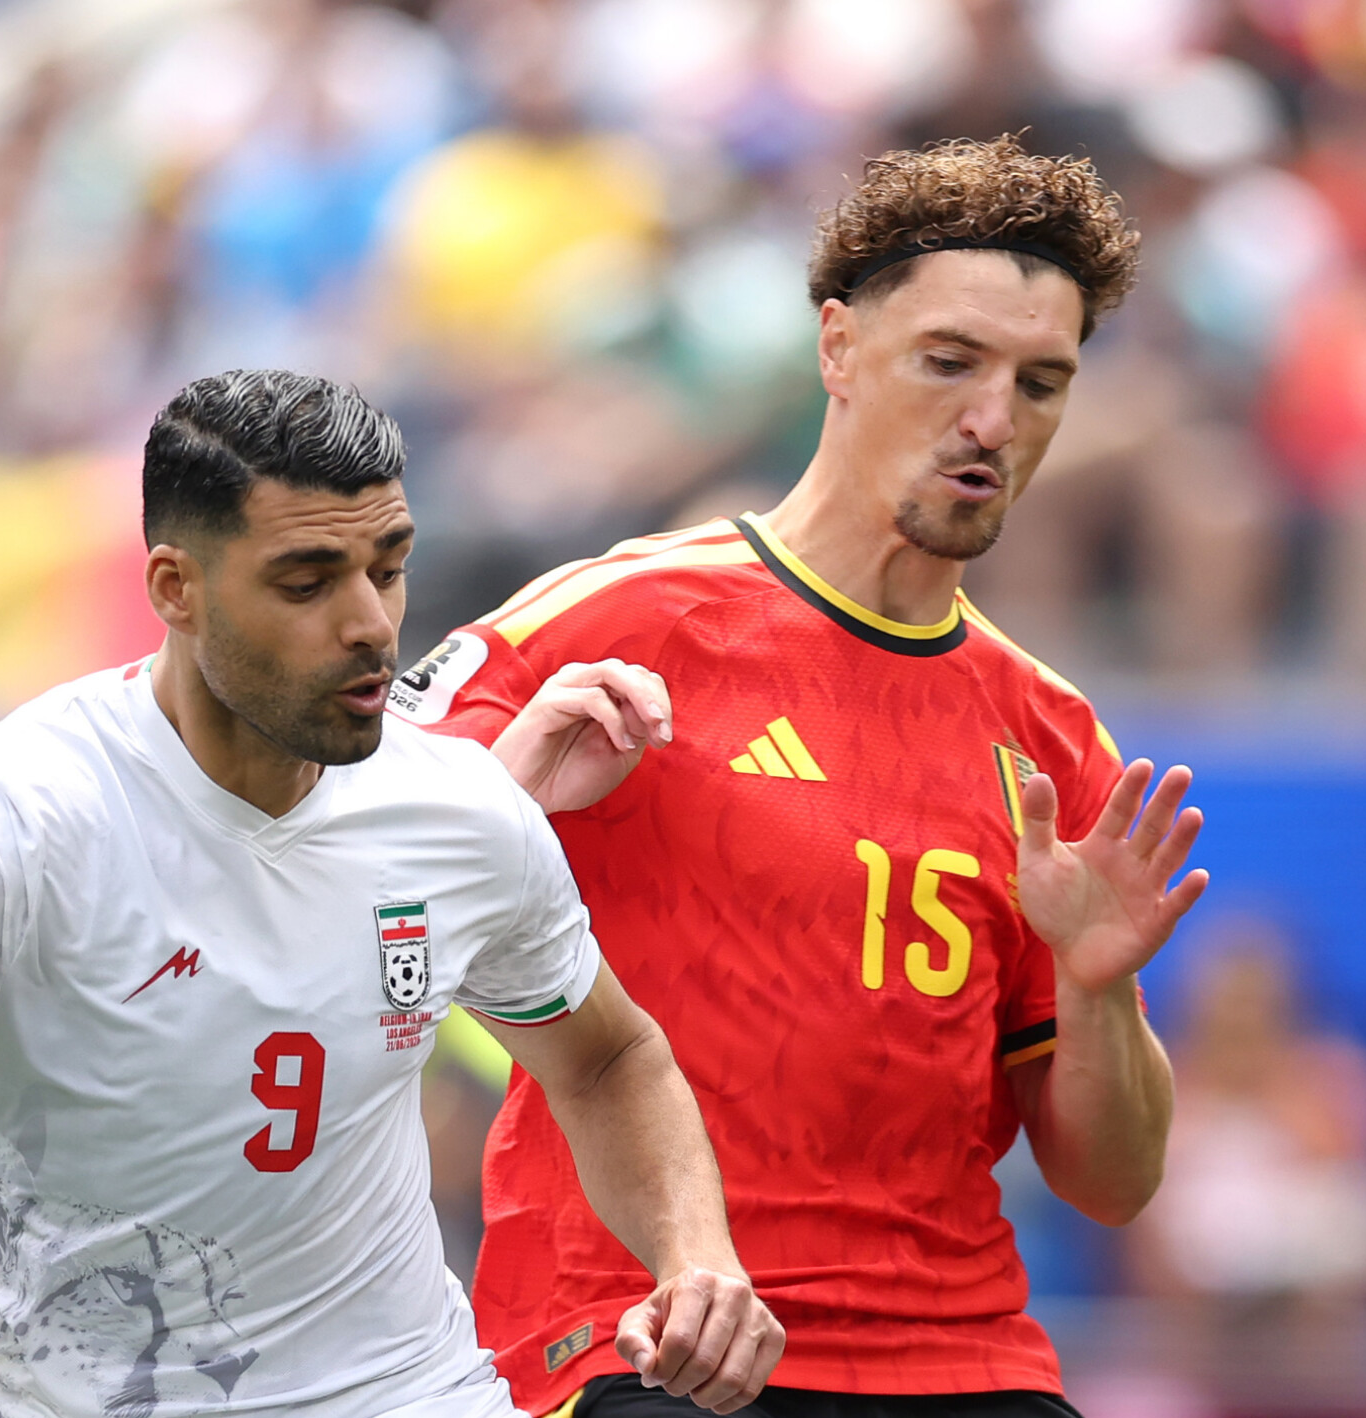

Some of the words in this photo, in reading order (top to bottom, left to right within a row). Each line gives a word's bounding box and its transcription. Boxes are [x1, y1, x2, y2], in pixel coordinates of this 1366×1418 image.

[388, 689, 419, 712] 026
[854, 838, 982, 998] 15
[242, 1030, 327, 1173] 9
